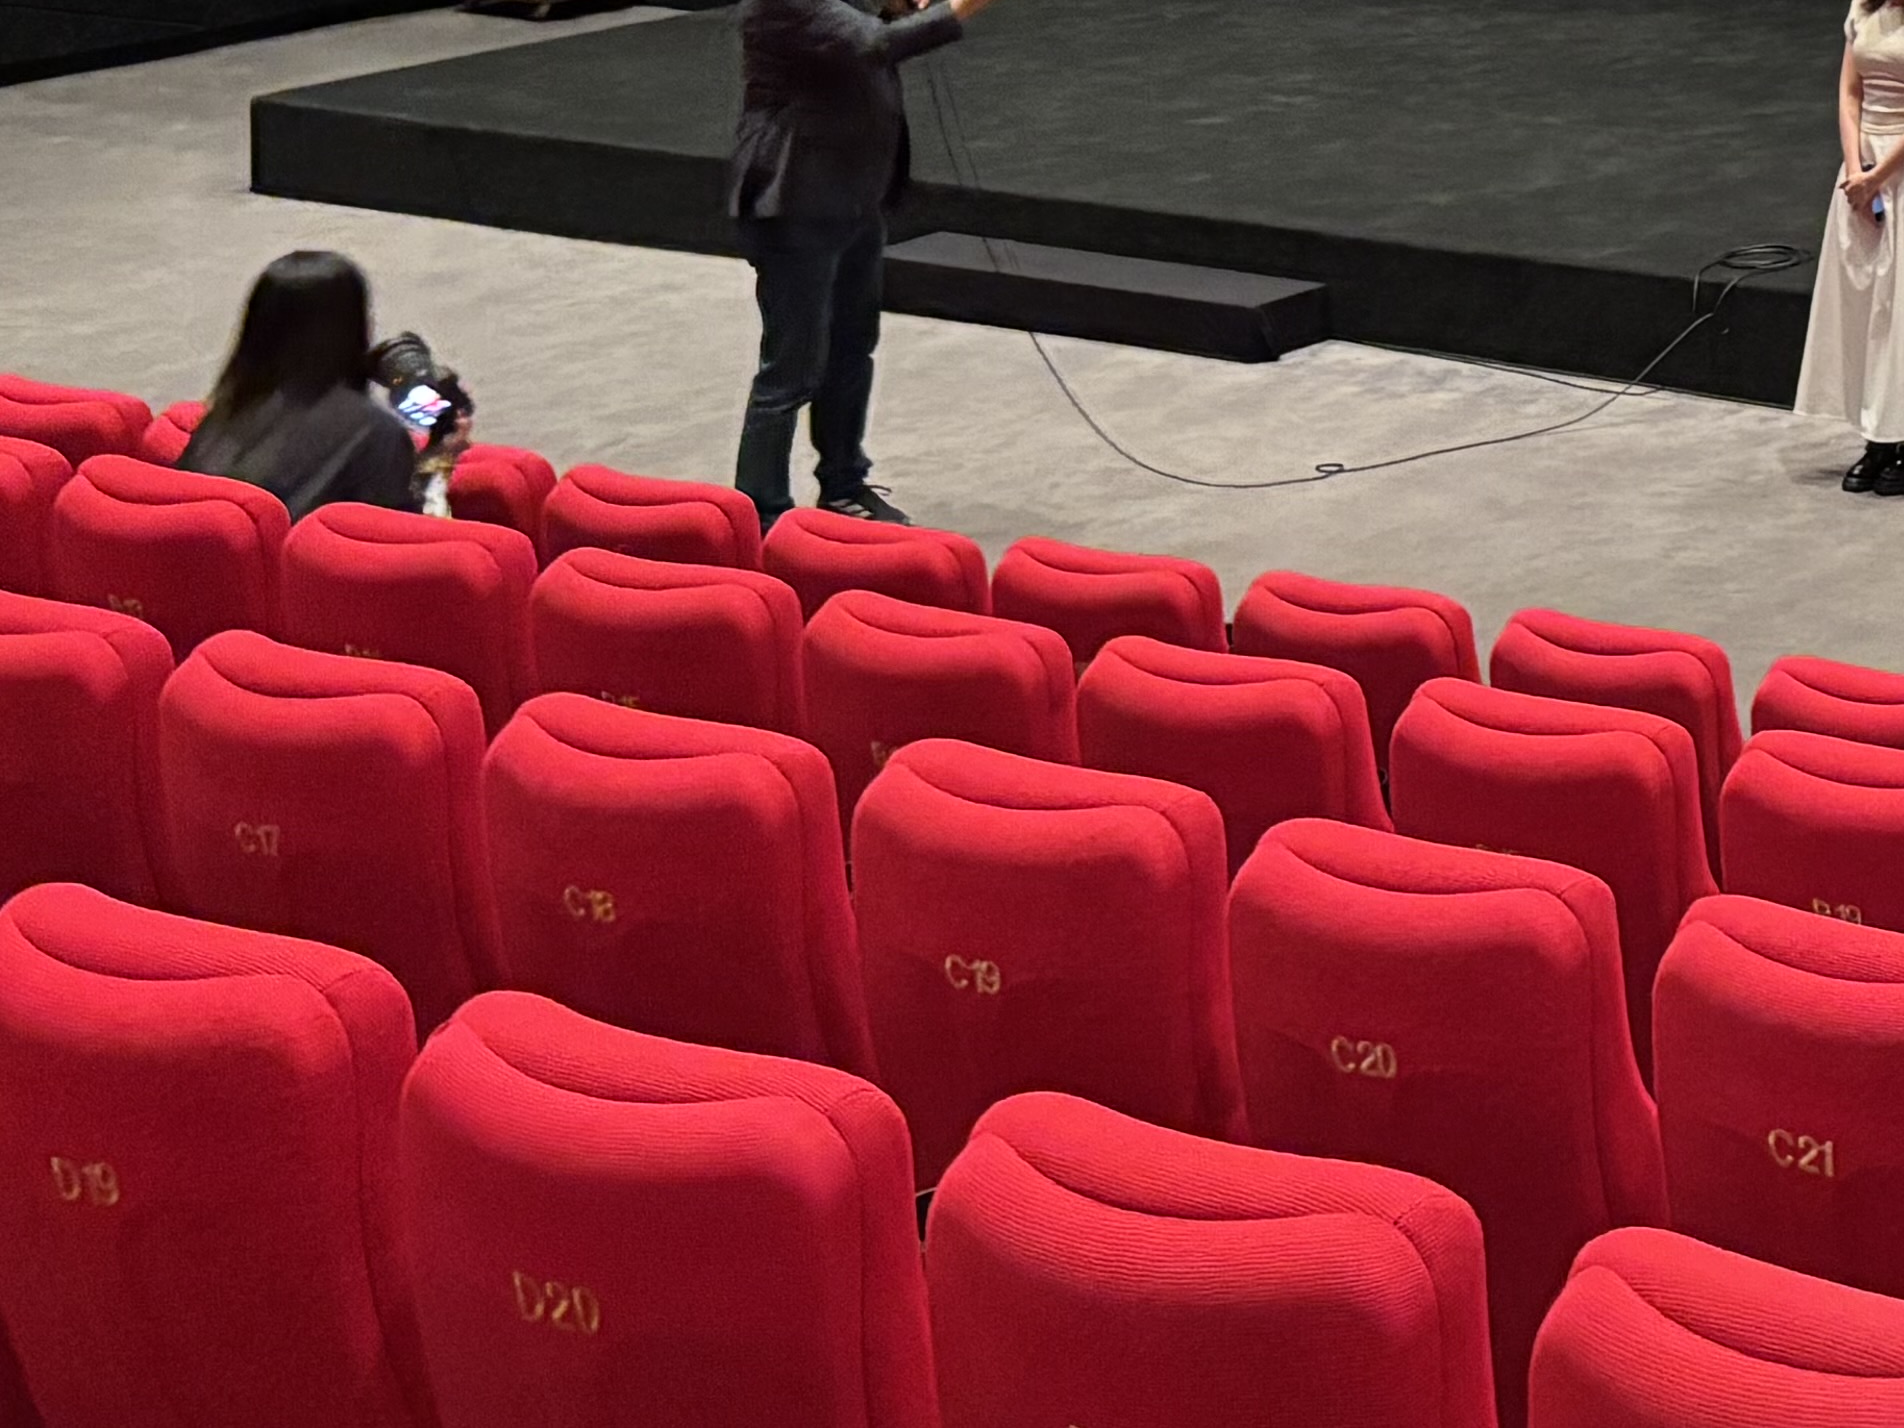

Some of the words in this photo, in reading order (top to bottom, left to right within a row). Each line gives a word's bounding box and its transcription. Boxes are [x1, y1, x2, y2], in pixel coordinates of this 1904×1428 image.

[233, 820, 281, 857] C17
[562, 884, 617, 923] C18
[944, 953, 1001, 996] C19
[1330, 1034, 1398, 1079] C20
[1768, 1128, 1837, 1178] C21
[50, 1156, 121, 1207] D19
[511, 1270, 602, 1335] D20
